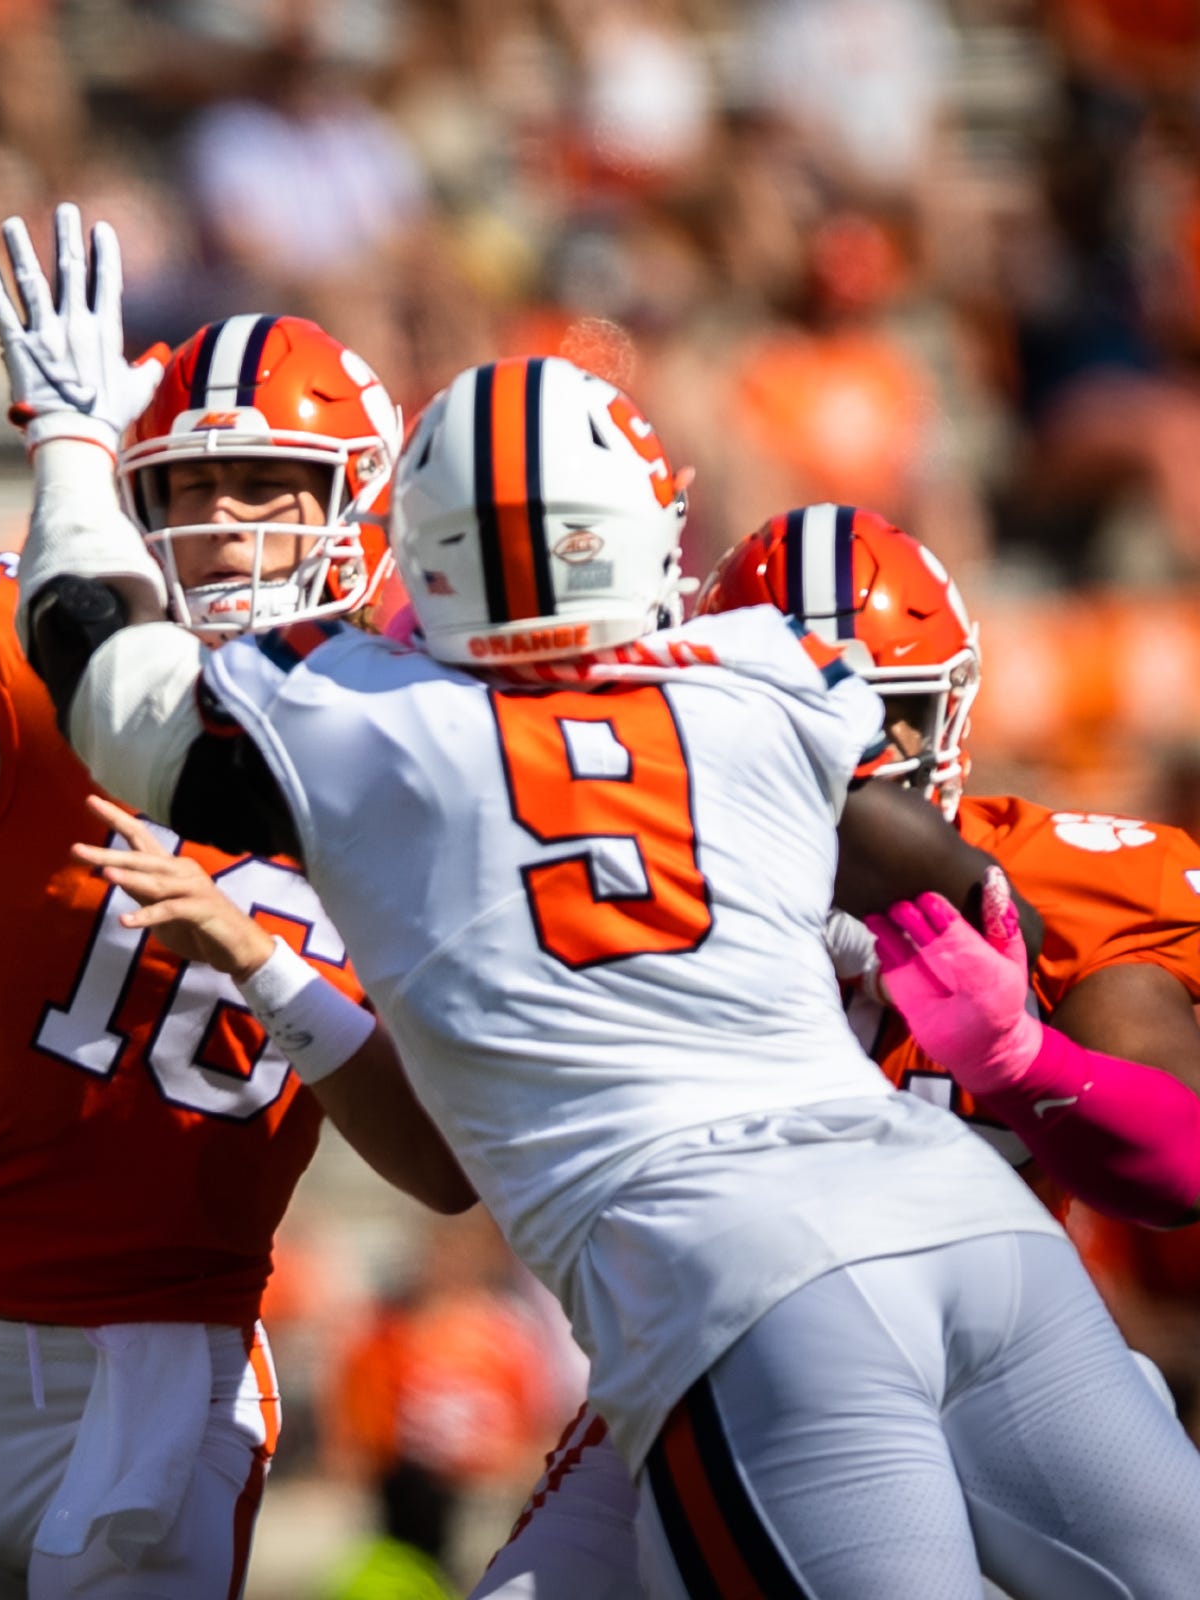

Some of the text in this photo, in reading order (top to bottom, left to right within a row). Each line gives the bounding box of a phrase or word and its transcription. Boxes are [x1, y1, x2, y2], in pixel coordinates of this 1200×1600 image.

[467, 624, 591, 658] ORANGE
[31, 818, 347, 1124] 16
[485, 681, 717, 973] 9
